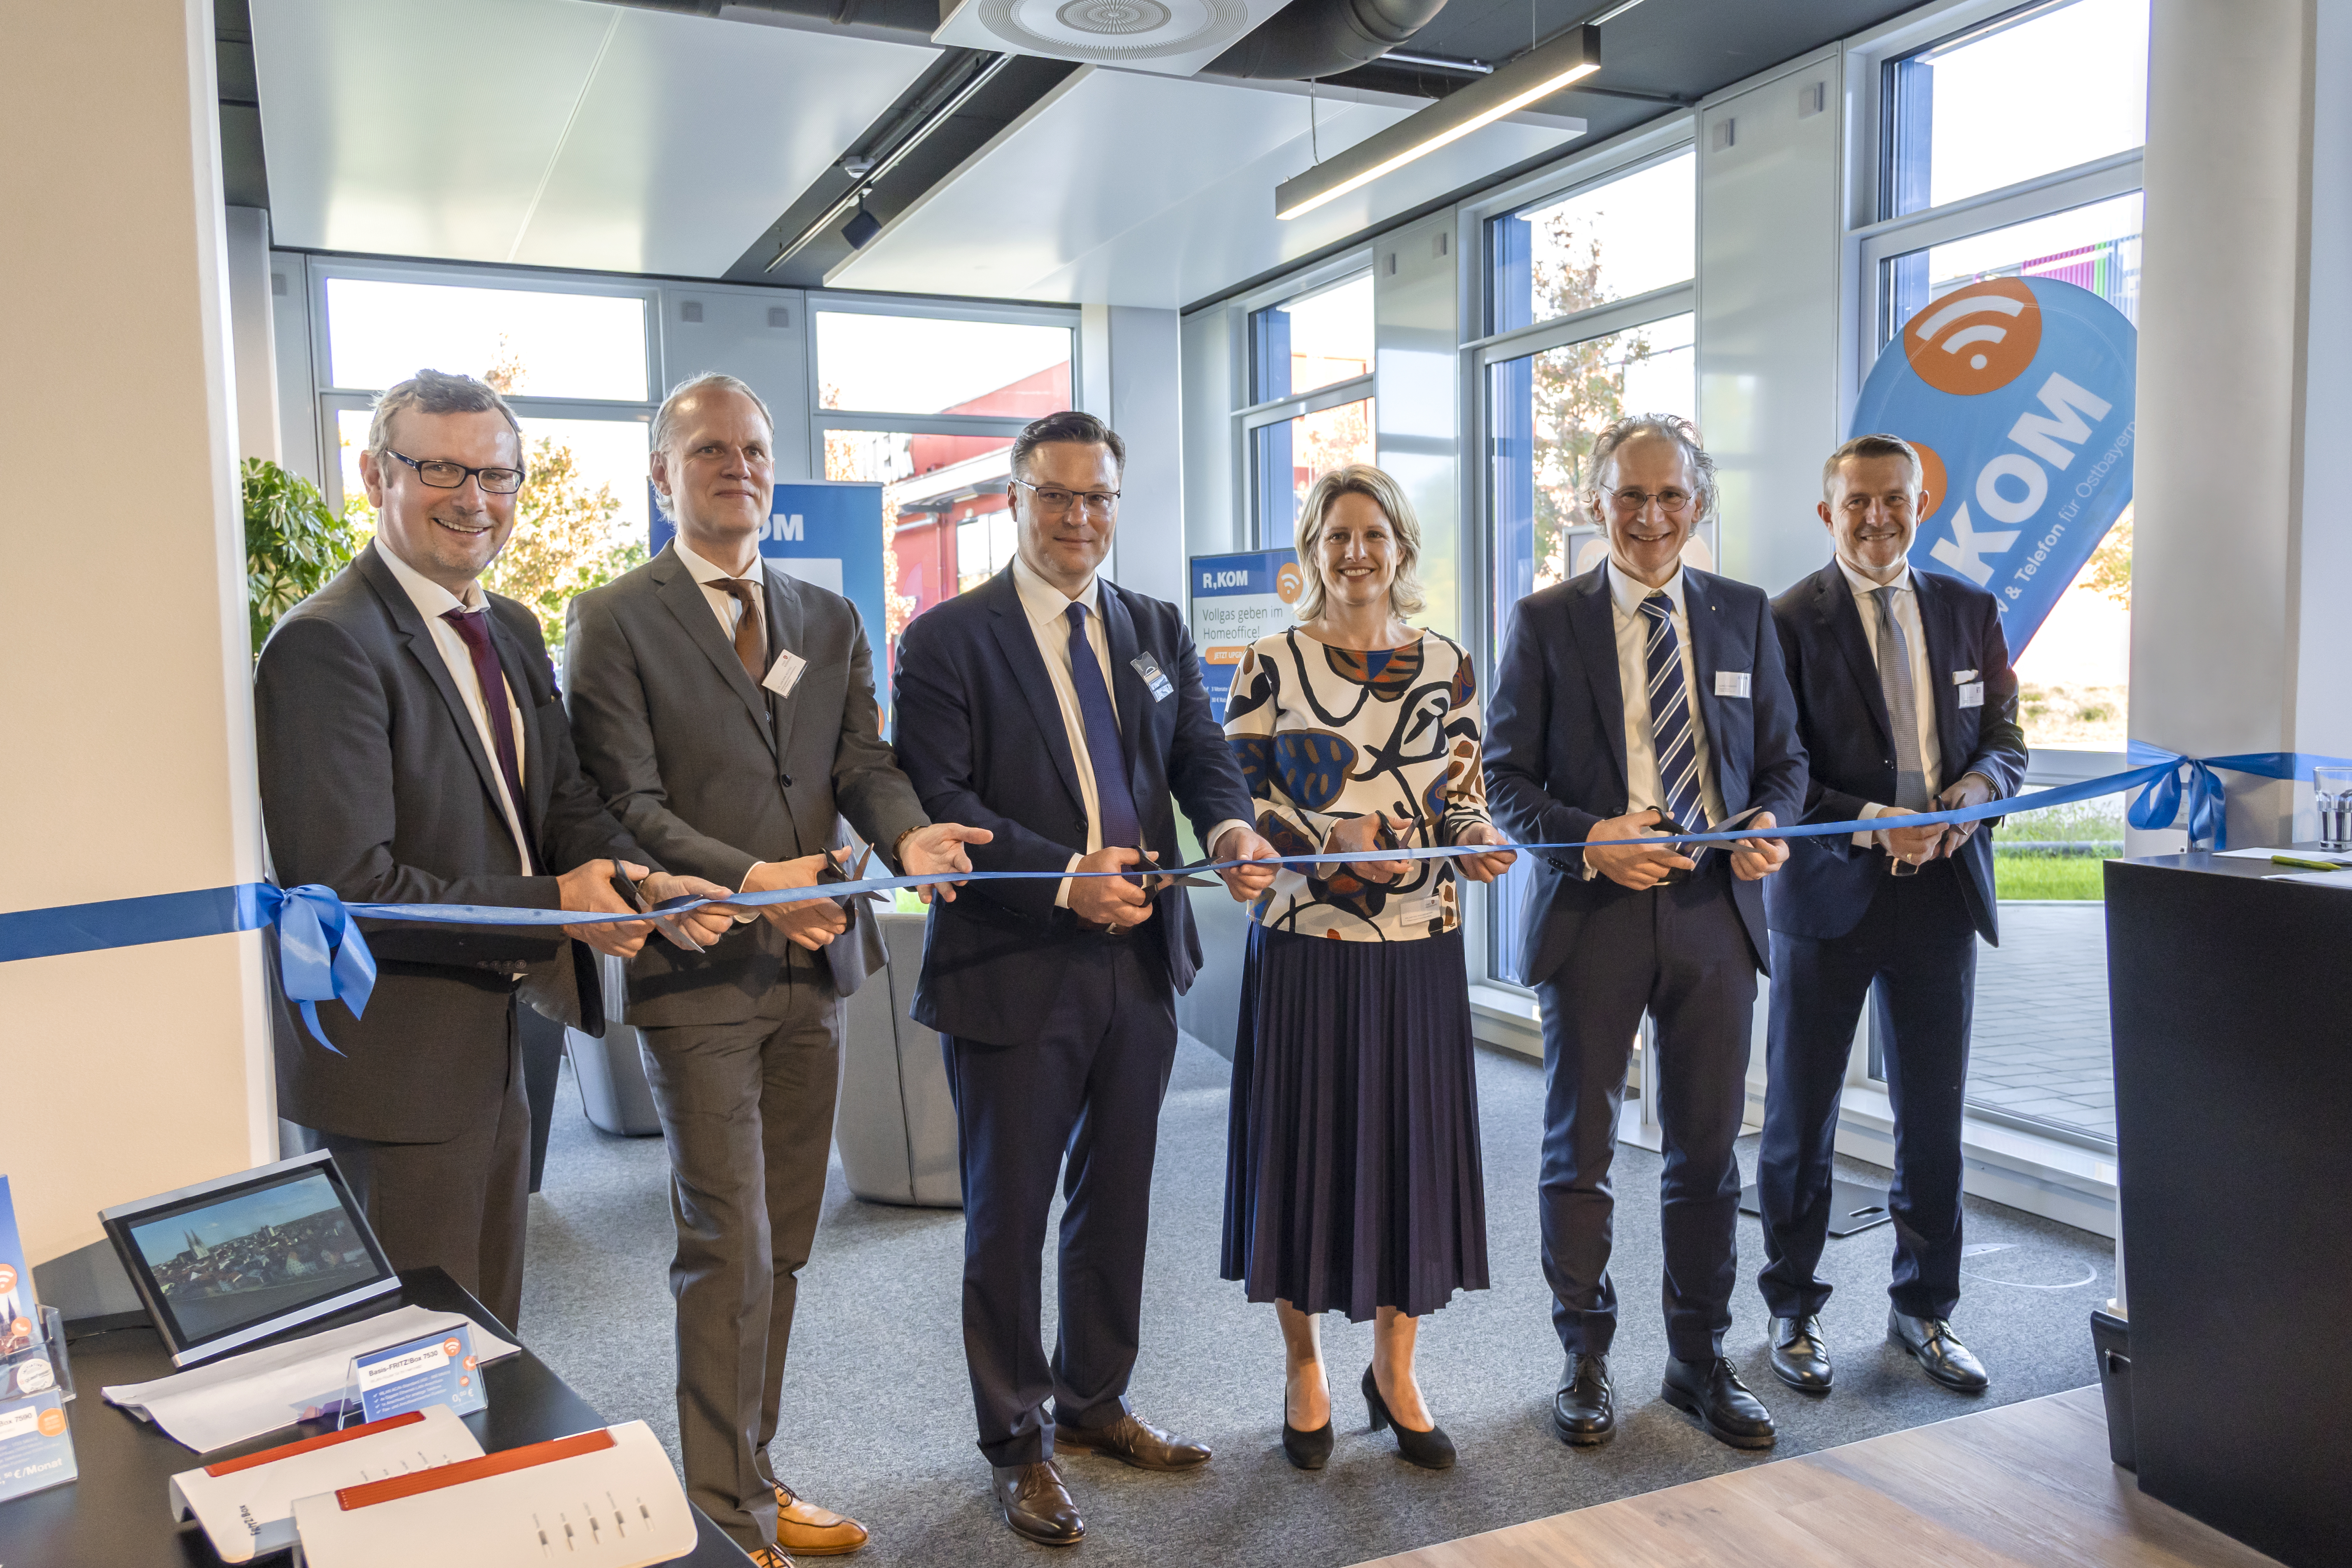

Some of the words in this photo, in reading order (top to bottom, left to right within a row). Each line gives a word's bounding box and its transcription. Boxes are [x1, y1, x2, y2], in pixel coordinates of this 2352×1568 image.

[2076, 421, 2135, 498] Ostbayern
[1929, 372, 2112, 587] KOM
[2059, 499, 2080, 522] für
[2013, 524, 2065, 582] Telefon
[2005, 586, 2022, 599] &
[1203, 608, 1235, 624] Vollgas
[1238, 606, 1267, 623] geben
[1271, 605, 1283, 618] im
[1203, 626, 1260, 639] Homeoffice!
[423, 1350, 438, 1359] 7530
[468, 1388, 474, 1397] €
[15, 1413, 33, 1422] 7590
